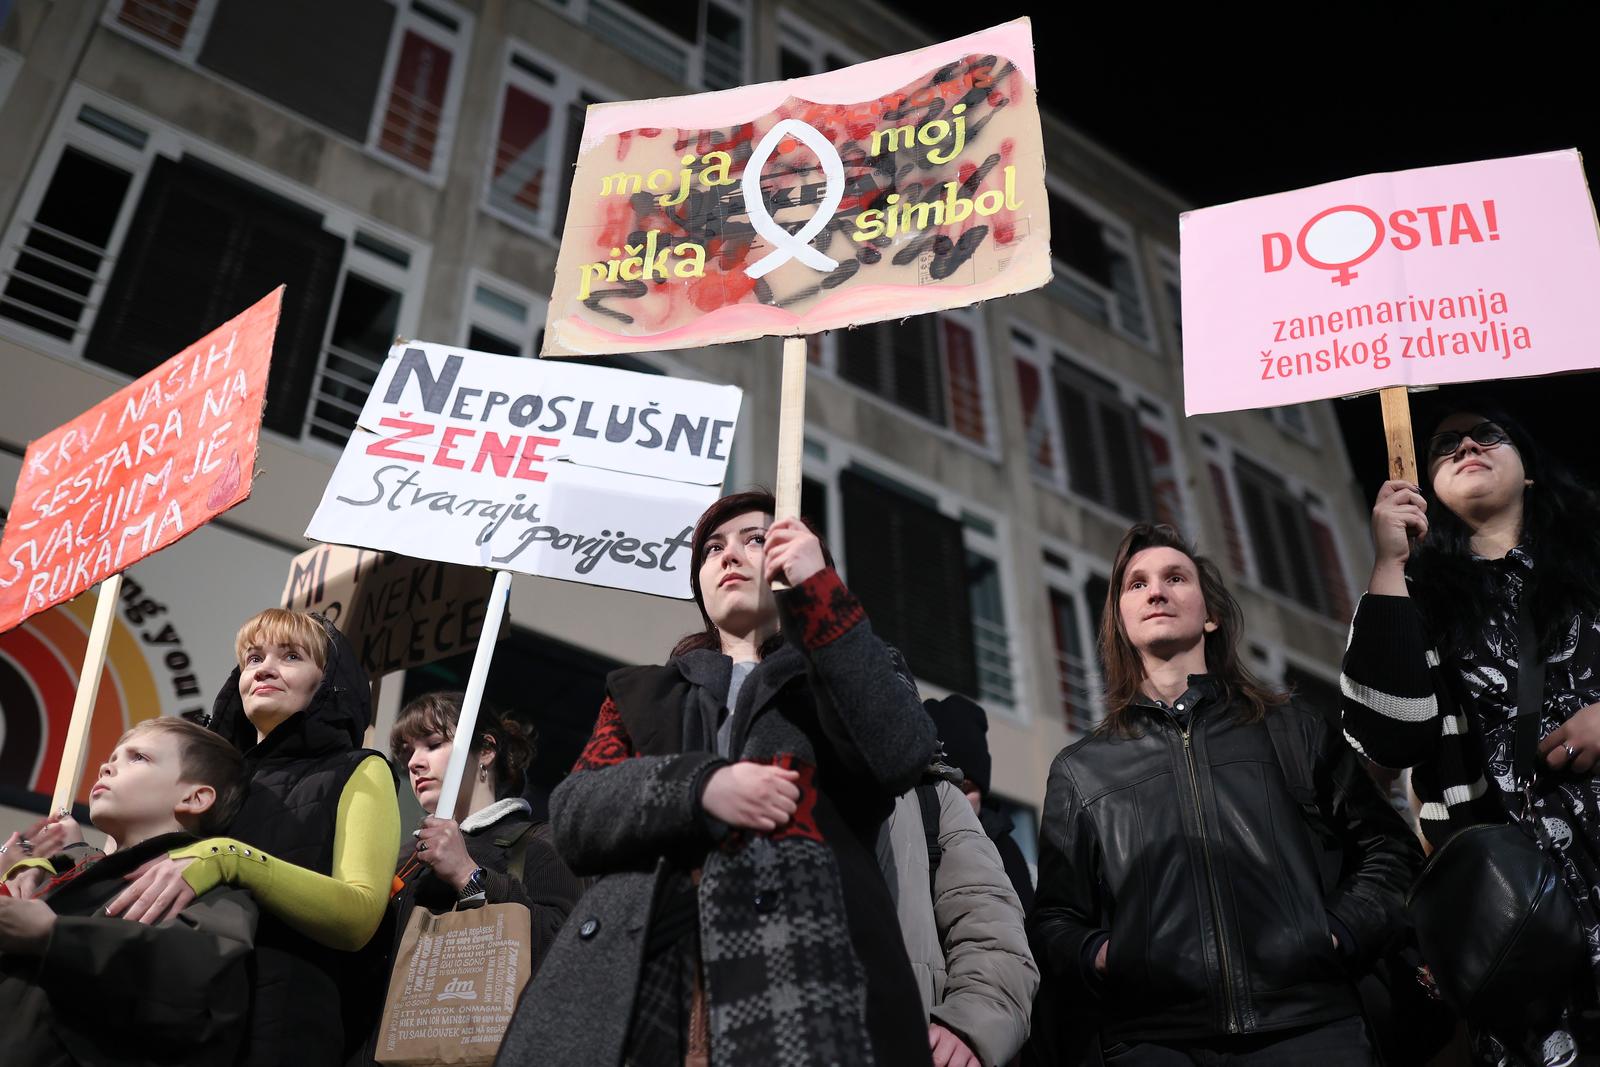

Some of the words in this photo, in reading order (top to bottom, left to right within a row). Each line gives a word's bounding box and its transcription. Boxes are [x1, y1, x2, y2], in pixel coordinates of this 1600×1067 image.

[870, 103, 966, 165] moj
[599, 149, 738, 207] moja
[851, 166, 1024, 243] simbol
[576, 229, 707, 301] pička
[1272, 288, 1508, 342] zanemarivanja
[1260, 333, 1391, 380] ženskog
[1400, 321, 1532, 360] zdravlja
[24, 412, 107, 490] KRV
[118, 331, 237, 433] NAŠIH
[383, 347, 734, 462] NEPOSLUŠNE
[20, 408, 183, 530] SESTARA
[199, 368, 247, 428] NA
[183, 421, 232, 483] JE
[365, 412, 561, 482] ŽENE
[337, 464, 541, 546] Stvaraju
[20, 499, 184, 620] RUKAMA
[491, 525, 693, 574] povijest
[120, 576, 168, 625] ng
[361, 562, 445, 632] NEKI
[142, 621, 201, 698] you
[444, 977, 475, 993] dm
[463, 957, 485, 966] SONO
[398, 1030, 408, 1040] TU
[408, 1029, 426, 1040] SAM
[427, 1026, 460, 1038] ČOVJEK
[400, 1010, 416, 1018] ITT
[418, 1007, 455, 1016] VAGYOK
